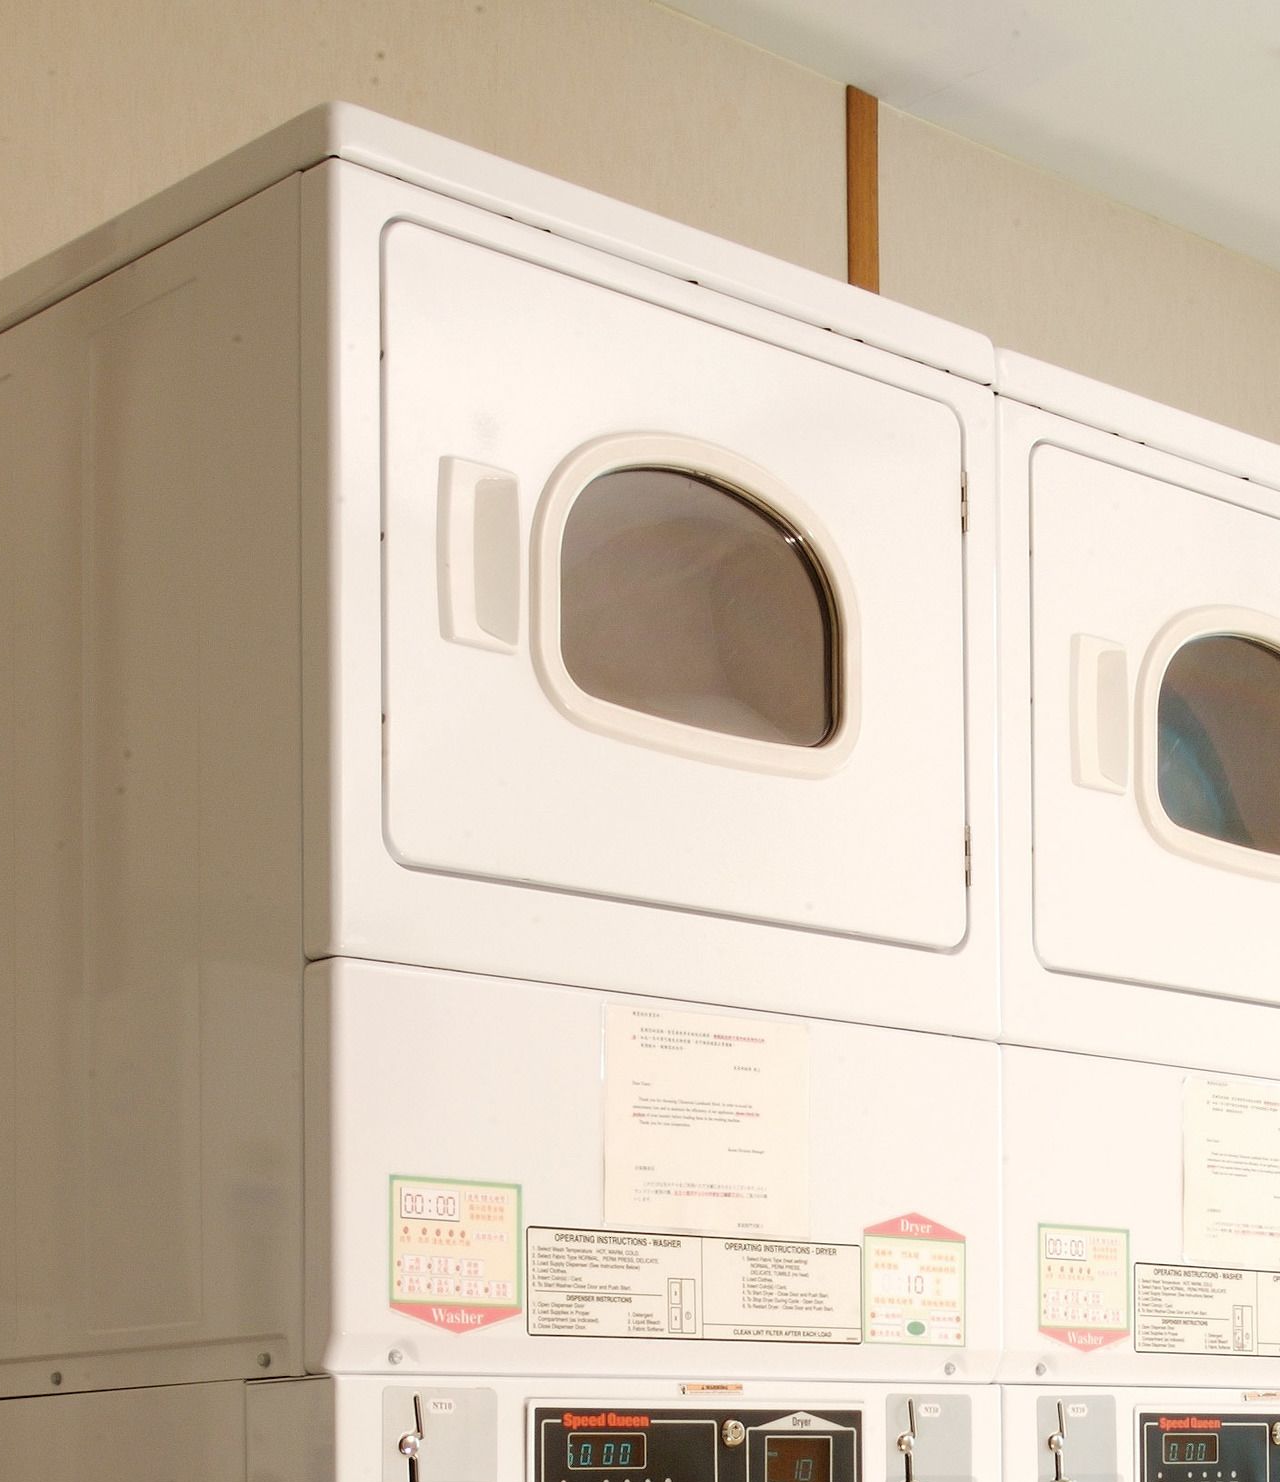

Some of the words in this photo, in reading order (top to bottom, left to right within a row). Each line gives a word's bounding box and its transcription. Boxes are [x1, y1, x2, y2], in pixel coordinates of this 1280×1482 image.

[901, 1219, 932, 1236] Dryer
[554, 1233, 595, 1244] OPERATING
[597, 1236, 647, 1246] INSTRUCTIONS
[653, 1239, 681, 1248] WASHER
[724, 1242, 762, 1253] OPERATING
[764, 1244, 810, 1254] INSTRUCTIONS
[815, 1247, 837, 1255] DRYER
[1183, 1270, 1218, 1279] INSTRUCTIONS
[432, 1308, 484, 1324] Washer
[1068, 1331, 1104, 1344] Washer
[563, 1412, 606, 1429] Speed
[607, 1412, 650, 1427] Queen
[792, 1417, 811, 1428] Dryer
[1159, 1417, 1190, 1431] Speed
[1191, 1418, 1221, 1428] Queen
